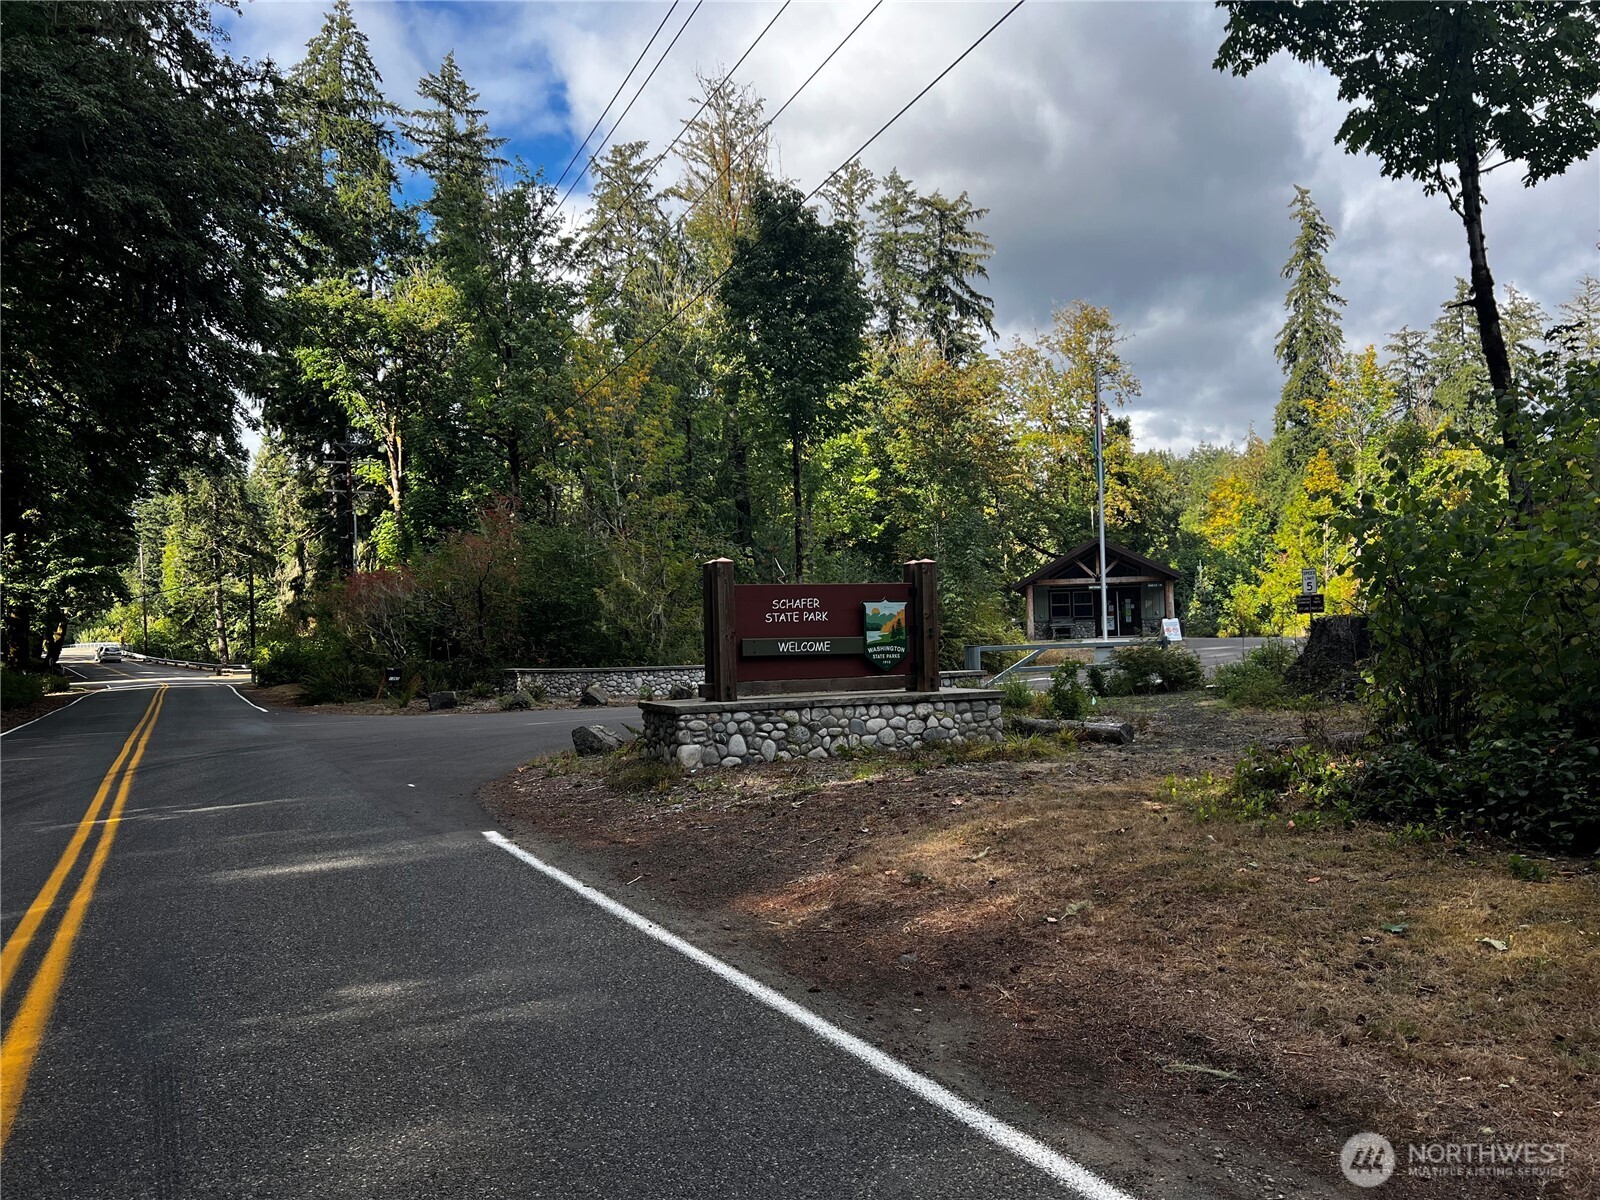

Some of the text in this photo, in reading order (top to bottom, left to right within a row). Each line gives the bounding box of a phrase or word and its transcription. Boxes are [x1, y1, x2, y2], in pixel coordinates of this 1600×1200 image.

[1306, 581, 1313, 592] 5
[772, 597, 821, 610] SCHAFER
[765, 611, 829, 623] STATE PARK
[777, 640, 831, 652] WELCOME
[867, 645, 906, 654] WASHINGTON
